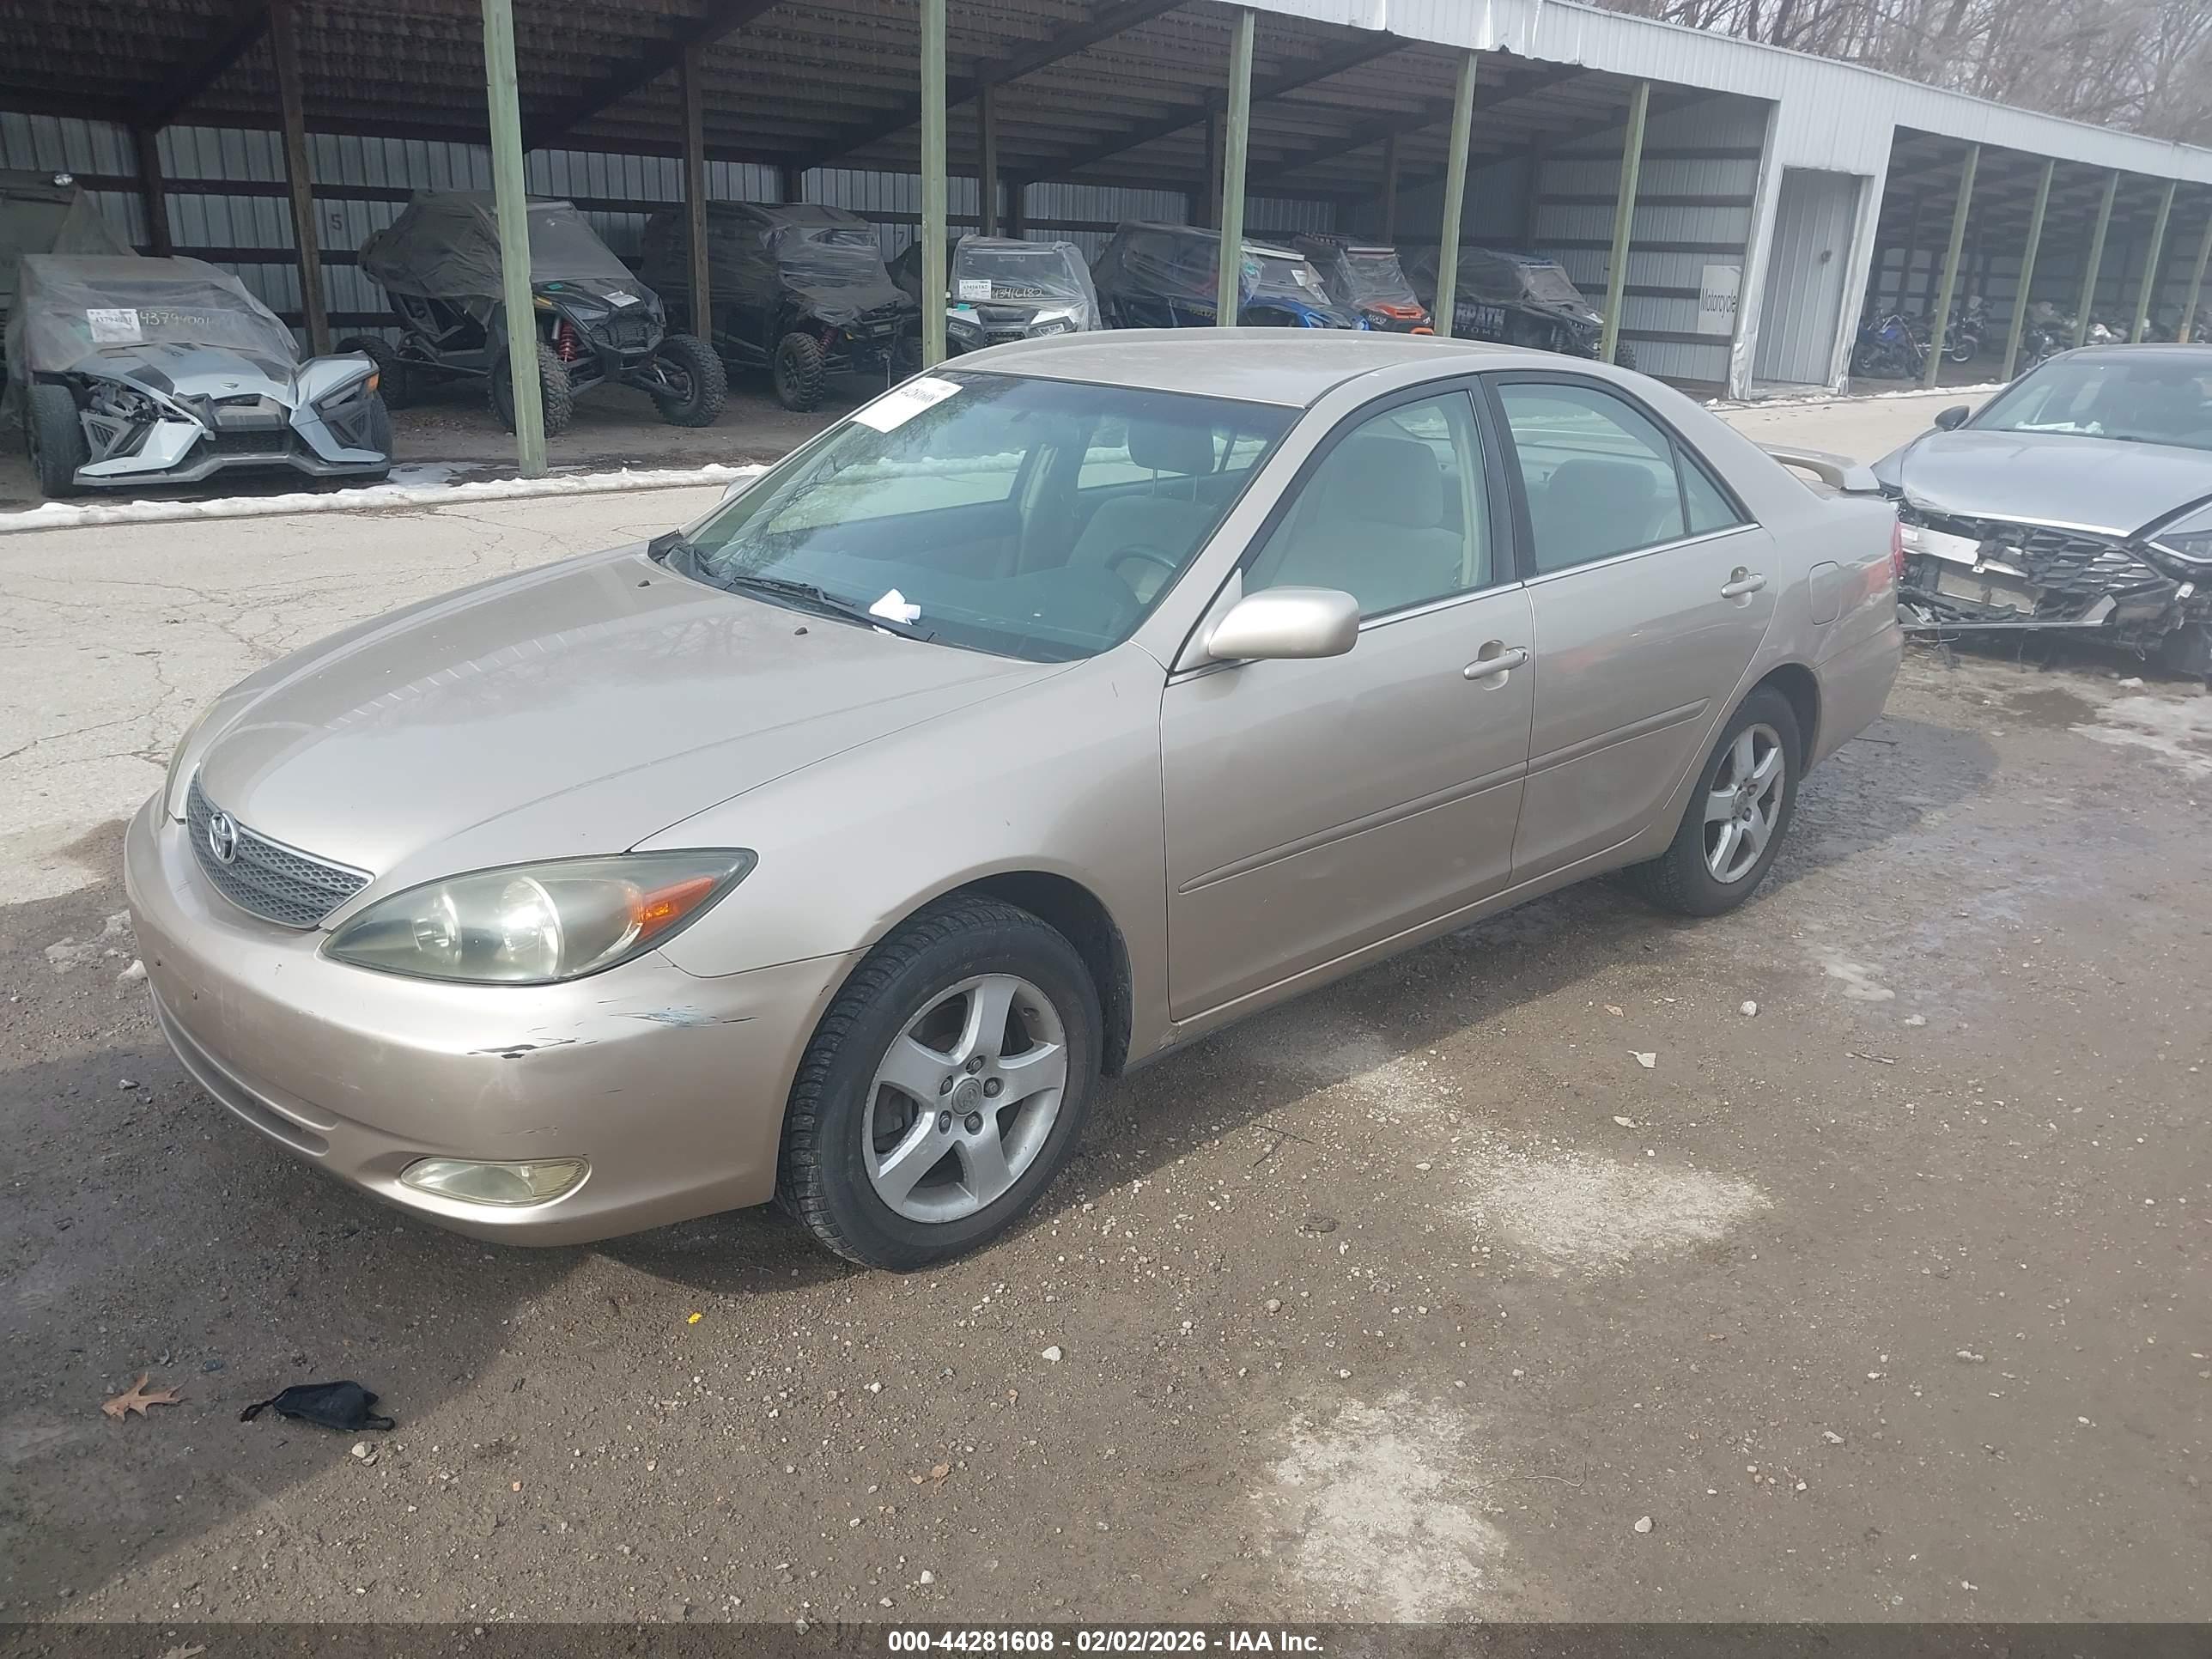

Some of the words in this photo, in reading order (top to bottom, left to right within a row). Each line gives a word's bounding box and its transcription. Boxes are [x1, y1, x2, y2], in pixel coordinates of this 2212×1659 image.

[331, 214, 343, 231] 5
[897, 231, 905, 245] 7
[1701, 289, 1737, 319] Motorcycle
